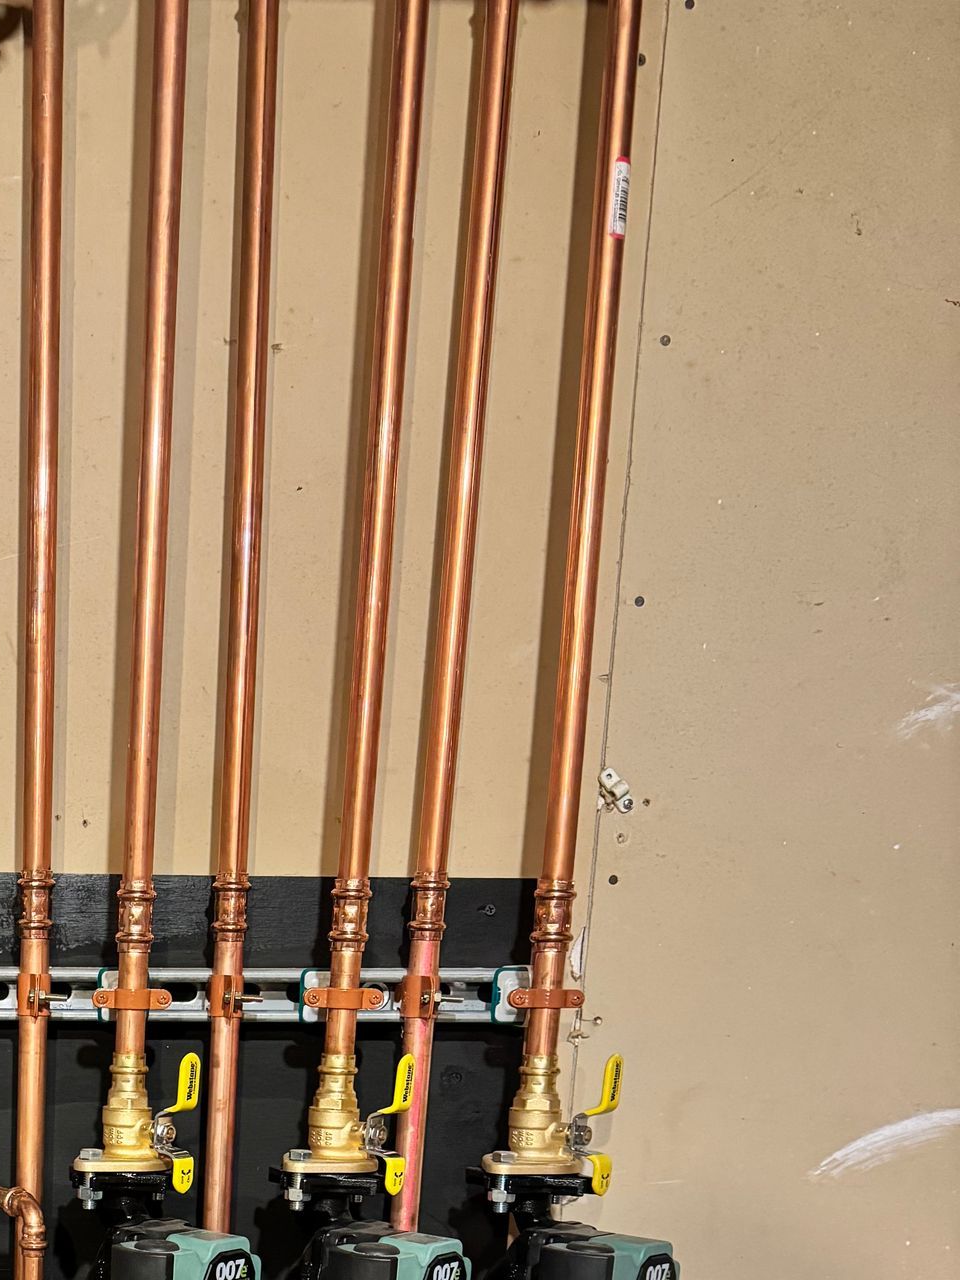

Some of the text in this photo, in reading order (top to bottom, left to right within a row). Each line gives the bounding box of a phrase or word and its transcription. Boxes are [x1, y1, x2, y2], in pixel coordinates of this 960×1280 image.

[186, 1061, 195, 1101] Webstone
[402, 1063, 412, 1102] Webstone
[610, 1061, 619, 1102] Webstone
